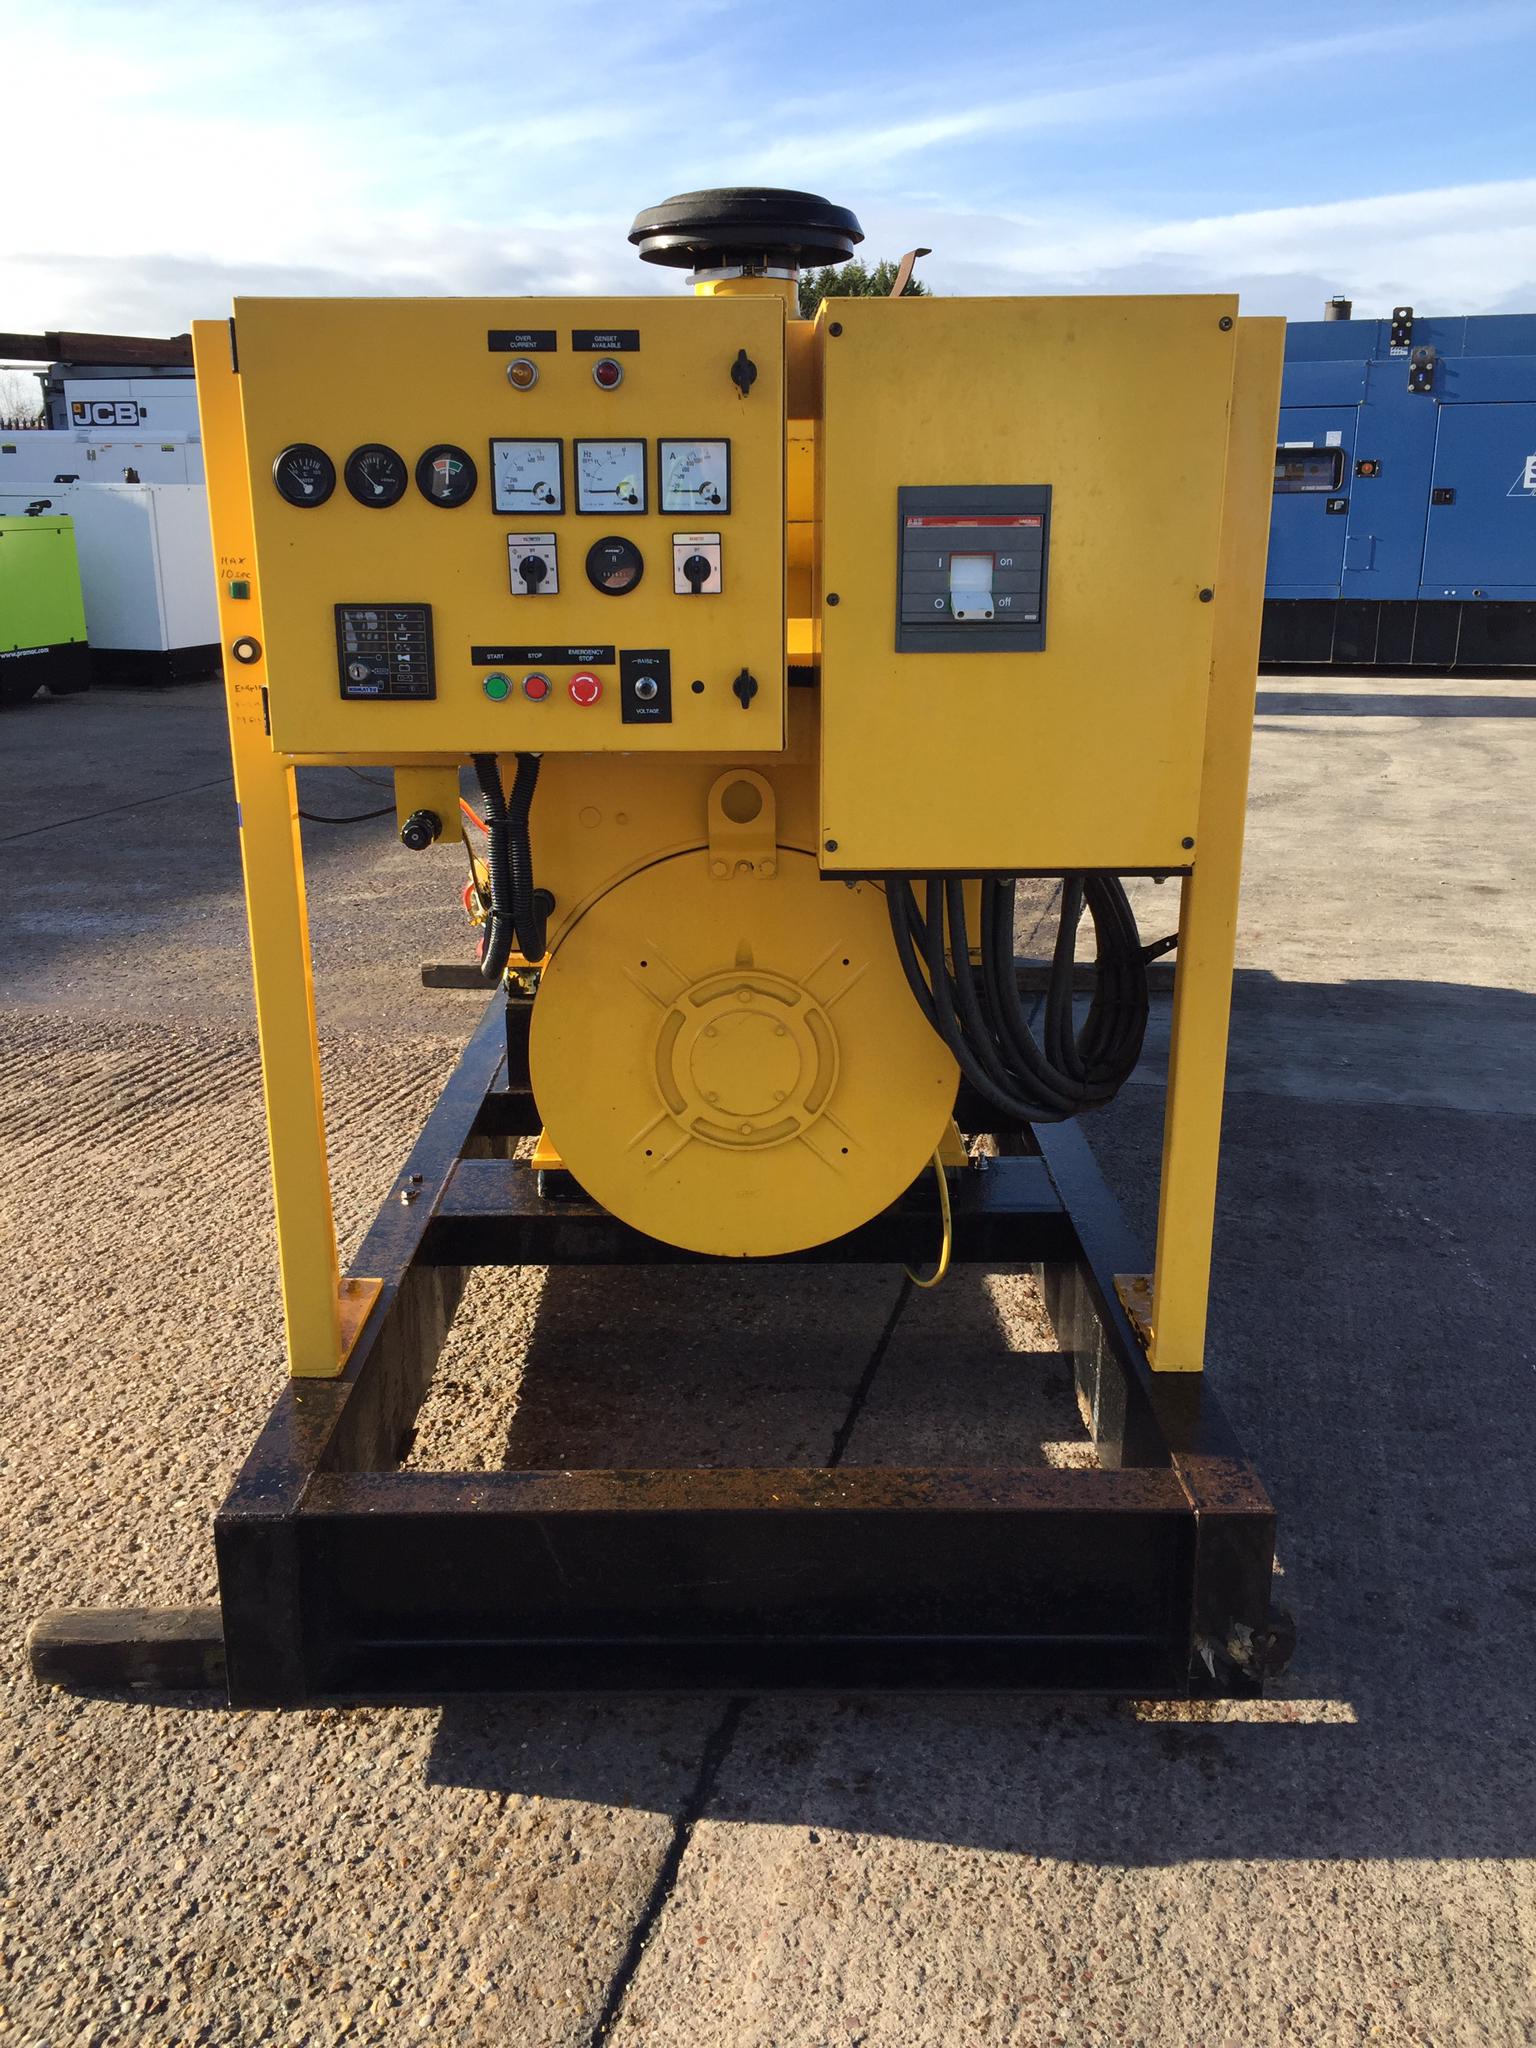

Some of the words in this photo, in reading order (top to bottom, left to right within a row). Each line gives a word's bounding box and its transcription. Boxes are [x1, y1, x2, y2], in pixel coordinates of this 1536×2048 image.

[74, 403, 138, 425] JCB
[502, 452, 509, 460] V
[583, 450, 592, 458] Hz
[670, 452, 677, 460] A
[1000, 558, 1013, 566] on
[998, 597, 1012, 607] off
